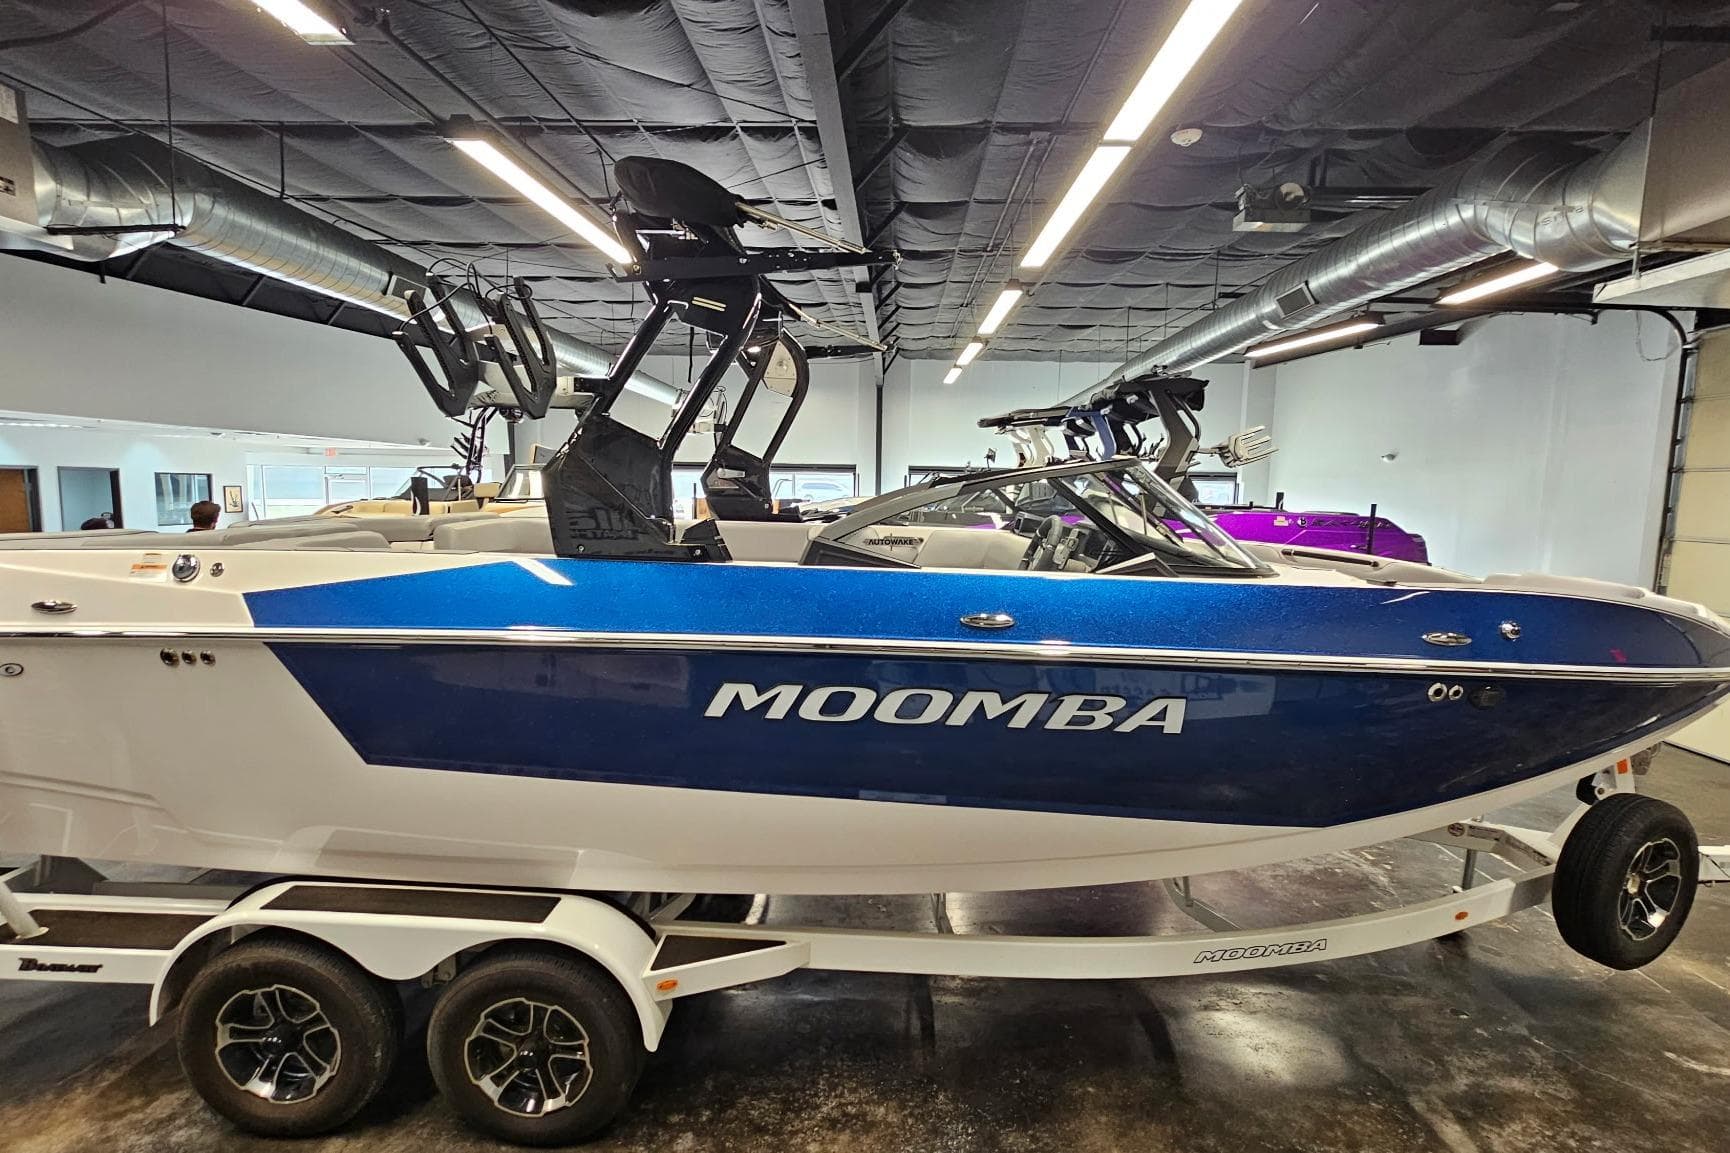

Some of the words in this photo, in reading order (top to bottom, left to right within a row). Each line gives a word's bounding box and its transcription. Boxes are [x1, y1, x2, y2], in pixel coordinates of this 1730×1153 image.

[868, 538, 914, 546] AUTOWAKE
[703, 682, 1188, 734] MOOMBA
[1193, 938, 1327, 963] MOOMBA
